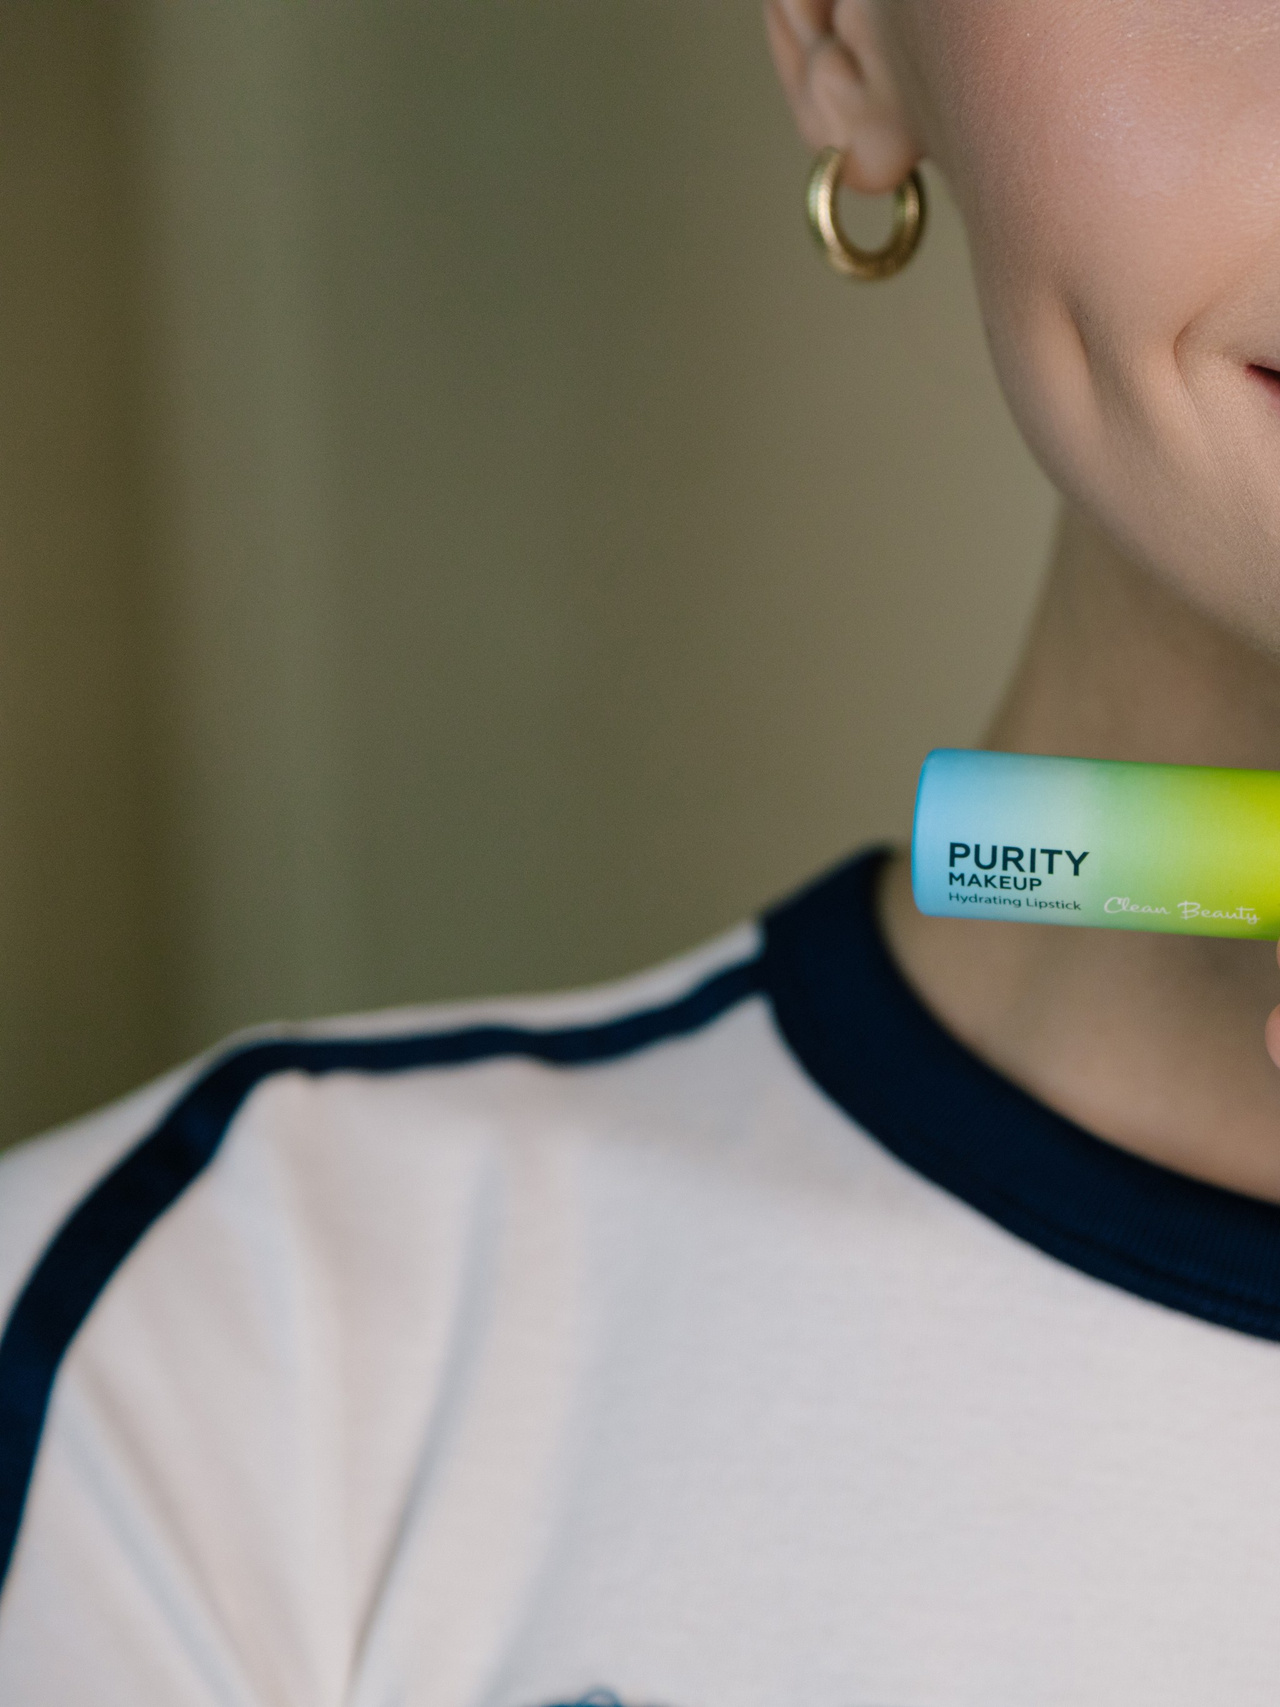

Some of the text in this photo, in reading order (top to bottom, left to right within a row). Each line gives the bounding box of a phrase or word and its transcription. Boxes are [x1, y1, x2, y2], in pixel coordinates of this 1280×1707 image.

[948, 842, 1090, 876] PURITY
[948, 872, 1042, 891] MAKEUP
[948, 892, 1082, 911] Hydrating Lipstick
[1103, 896, 1261, 925] Clean Beauty
